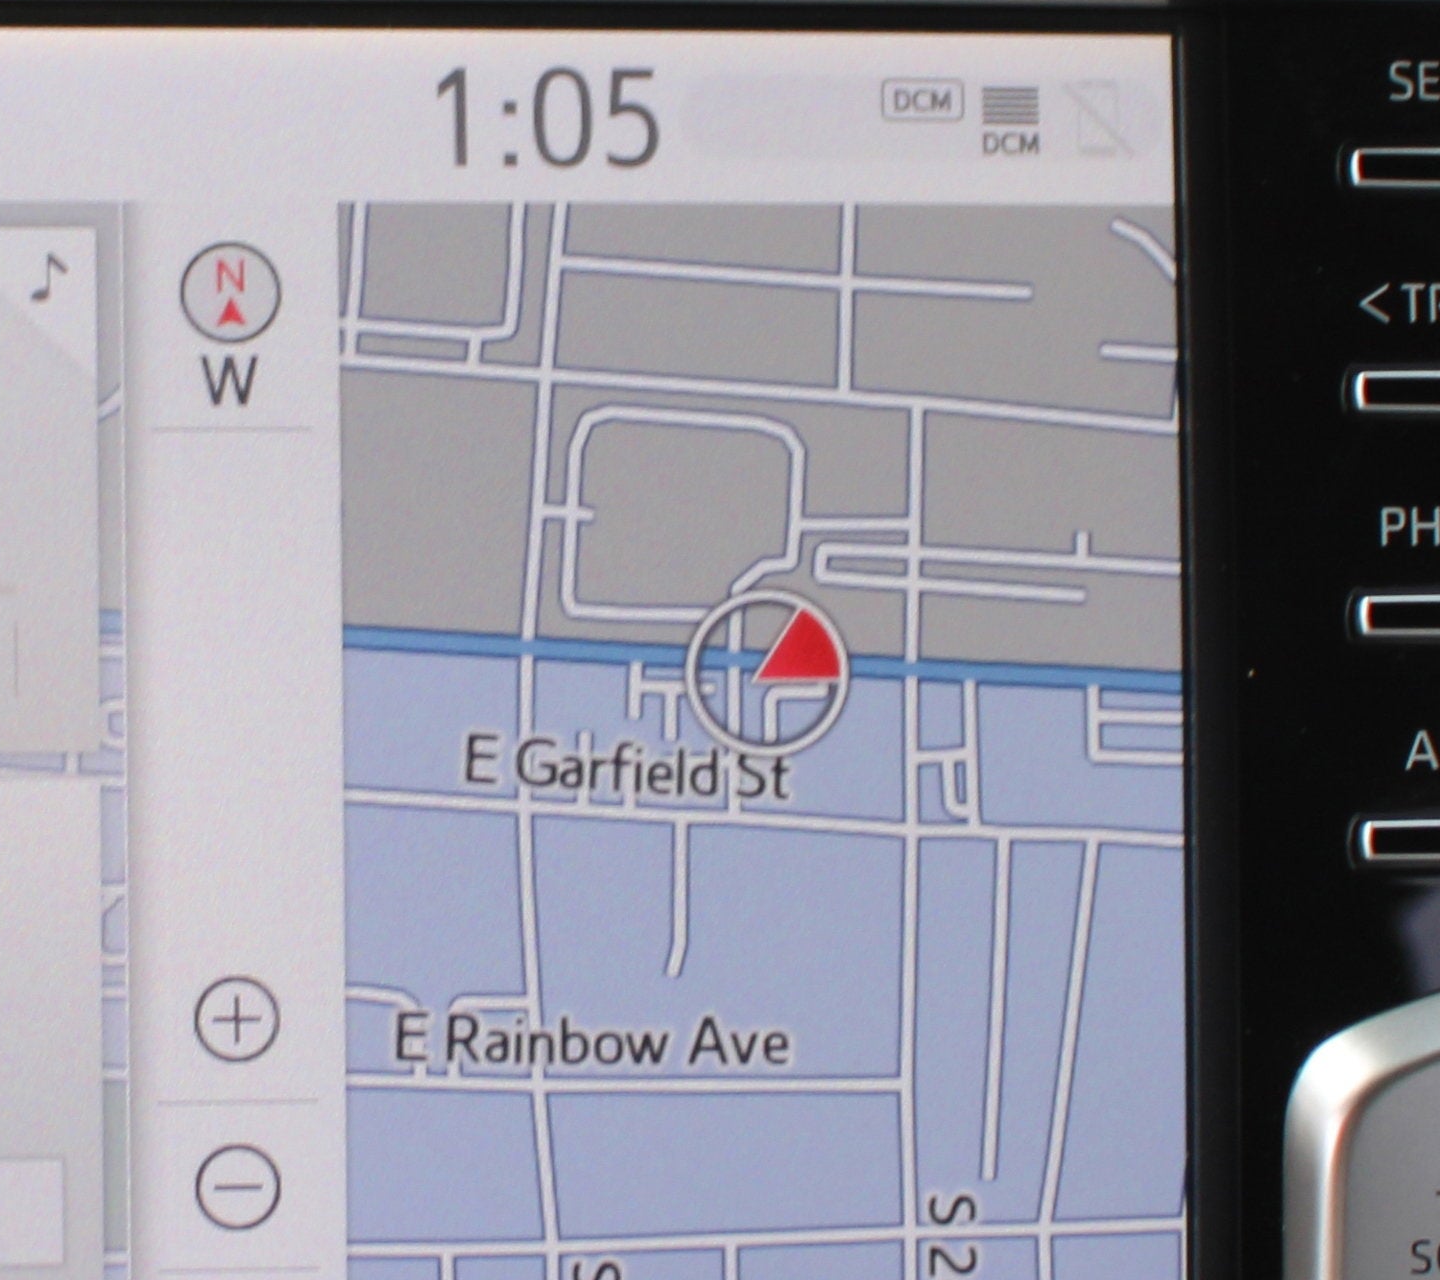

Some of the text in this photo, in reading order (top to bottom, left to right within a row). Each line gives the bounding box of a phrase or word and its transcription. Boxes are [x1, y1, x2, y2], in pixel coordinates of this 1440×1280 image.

[435, 66, 661, 169] 1:05
[894, 88, 953, 113] DCM
[982, 131, 1041, 156] DCM
[215, 257, 246, 294] N
[201, 353, 259, 407] W
[465, 733, 791, 800] E Garfield St
[395, 1011, 791, 1066] E Rainbow Ave
[928, 1194, 977, 1225] S
